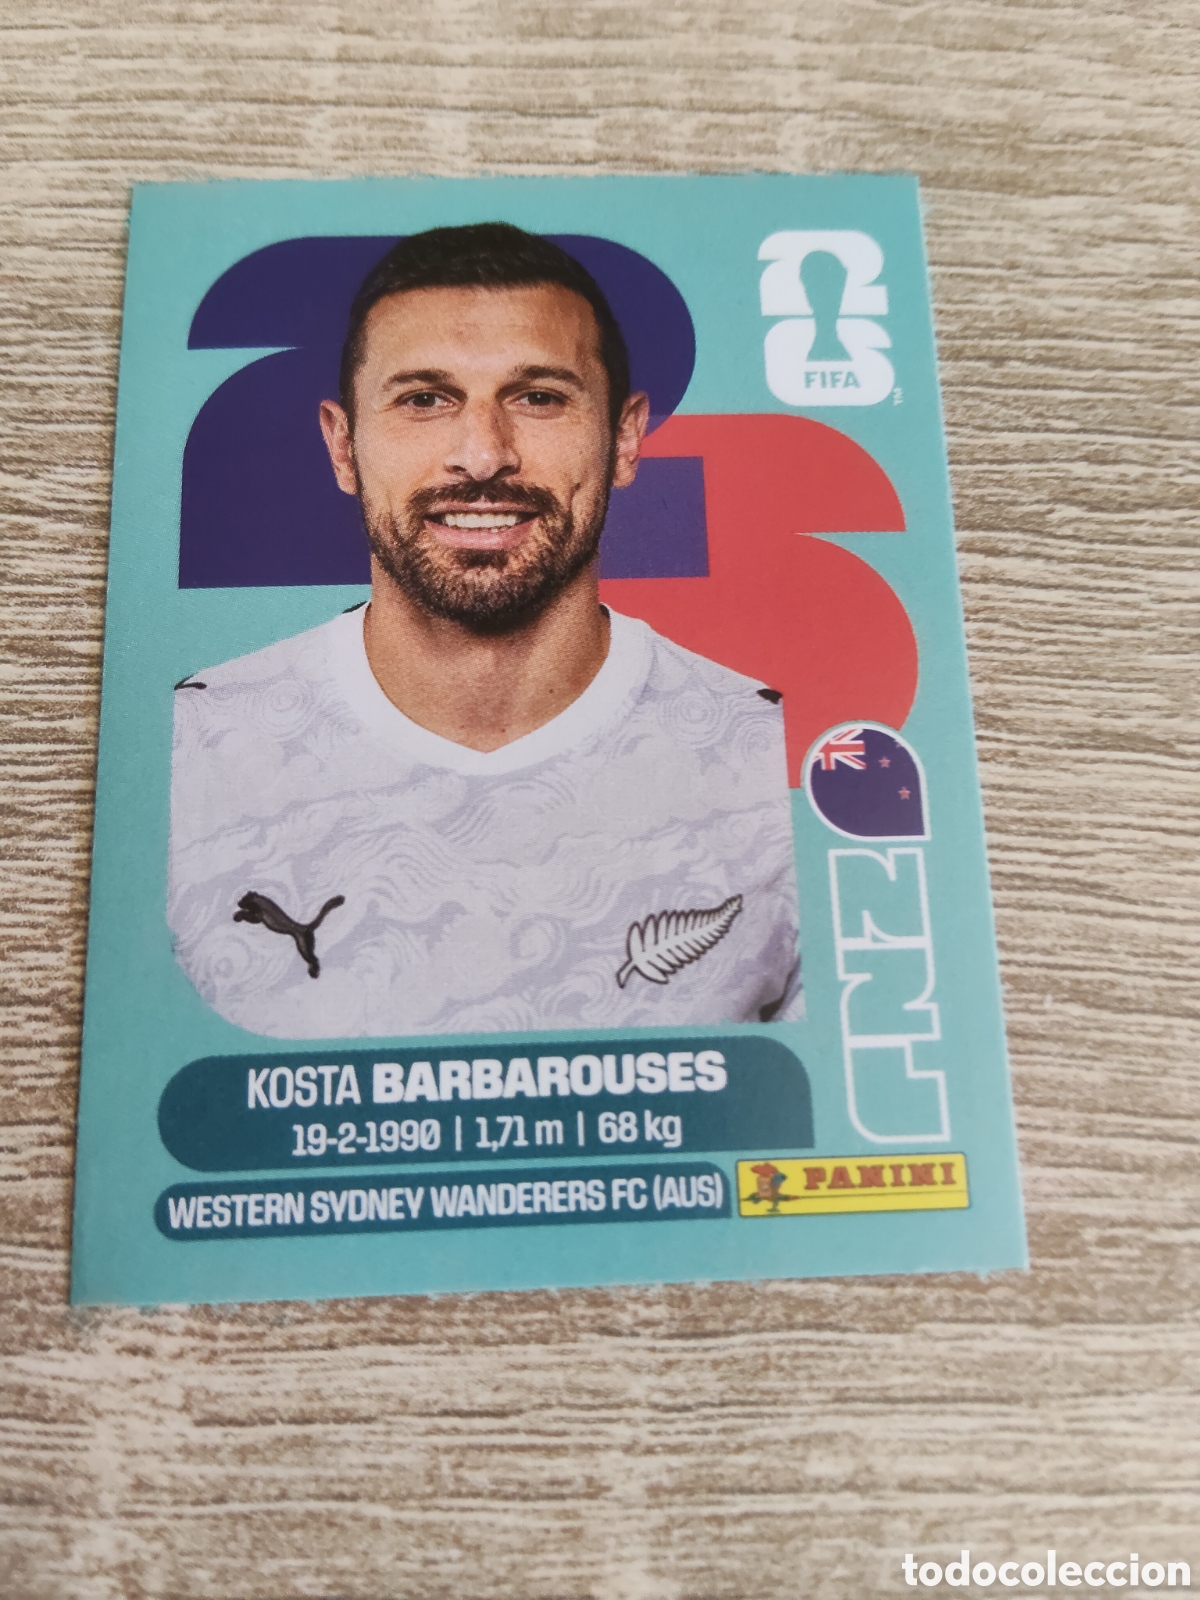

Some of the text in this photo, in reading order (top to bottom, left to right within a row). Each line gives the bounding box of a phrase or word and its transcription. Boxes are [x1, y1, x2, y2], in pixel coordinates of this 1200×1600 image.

[804, 371, 861, 389] FIFA
[247, 1050, 728, 1109] KOSTA BARBAROUSES
[292, 1118, 441, 1156] 19-2-1990
[475, 1114, 527, 1152] 1,71
[534, 1117, 565, 1146] m
[598, 1111, 638, 1144] 68
[643, 1109, 683, 1149] kg
[168, 1172, 724, 1229] WESTERN SYDNEY WANDERERS FC (AUS)
[803, 1162, 958, 1192] PANINI
